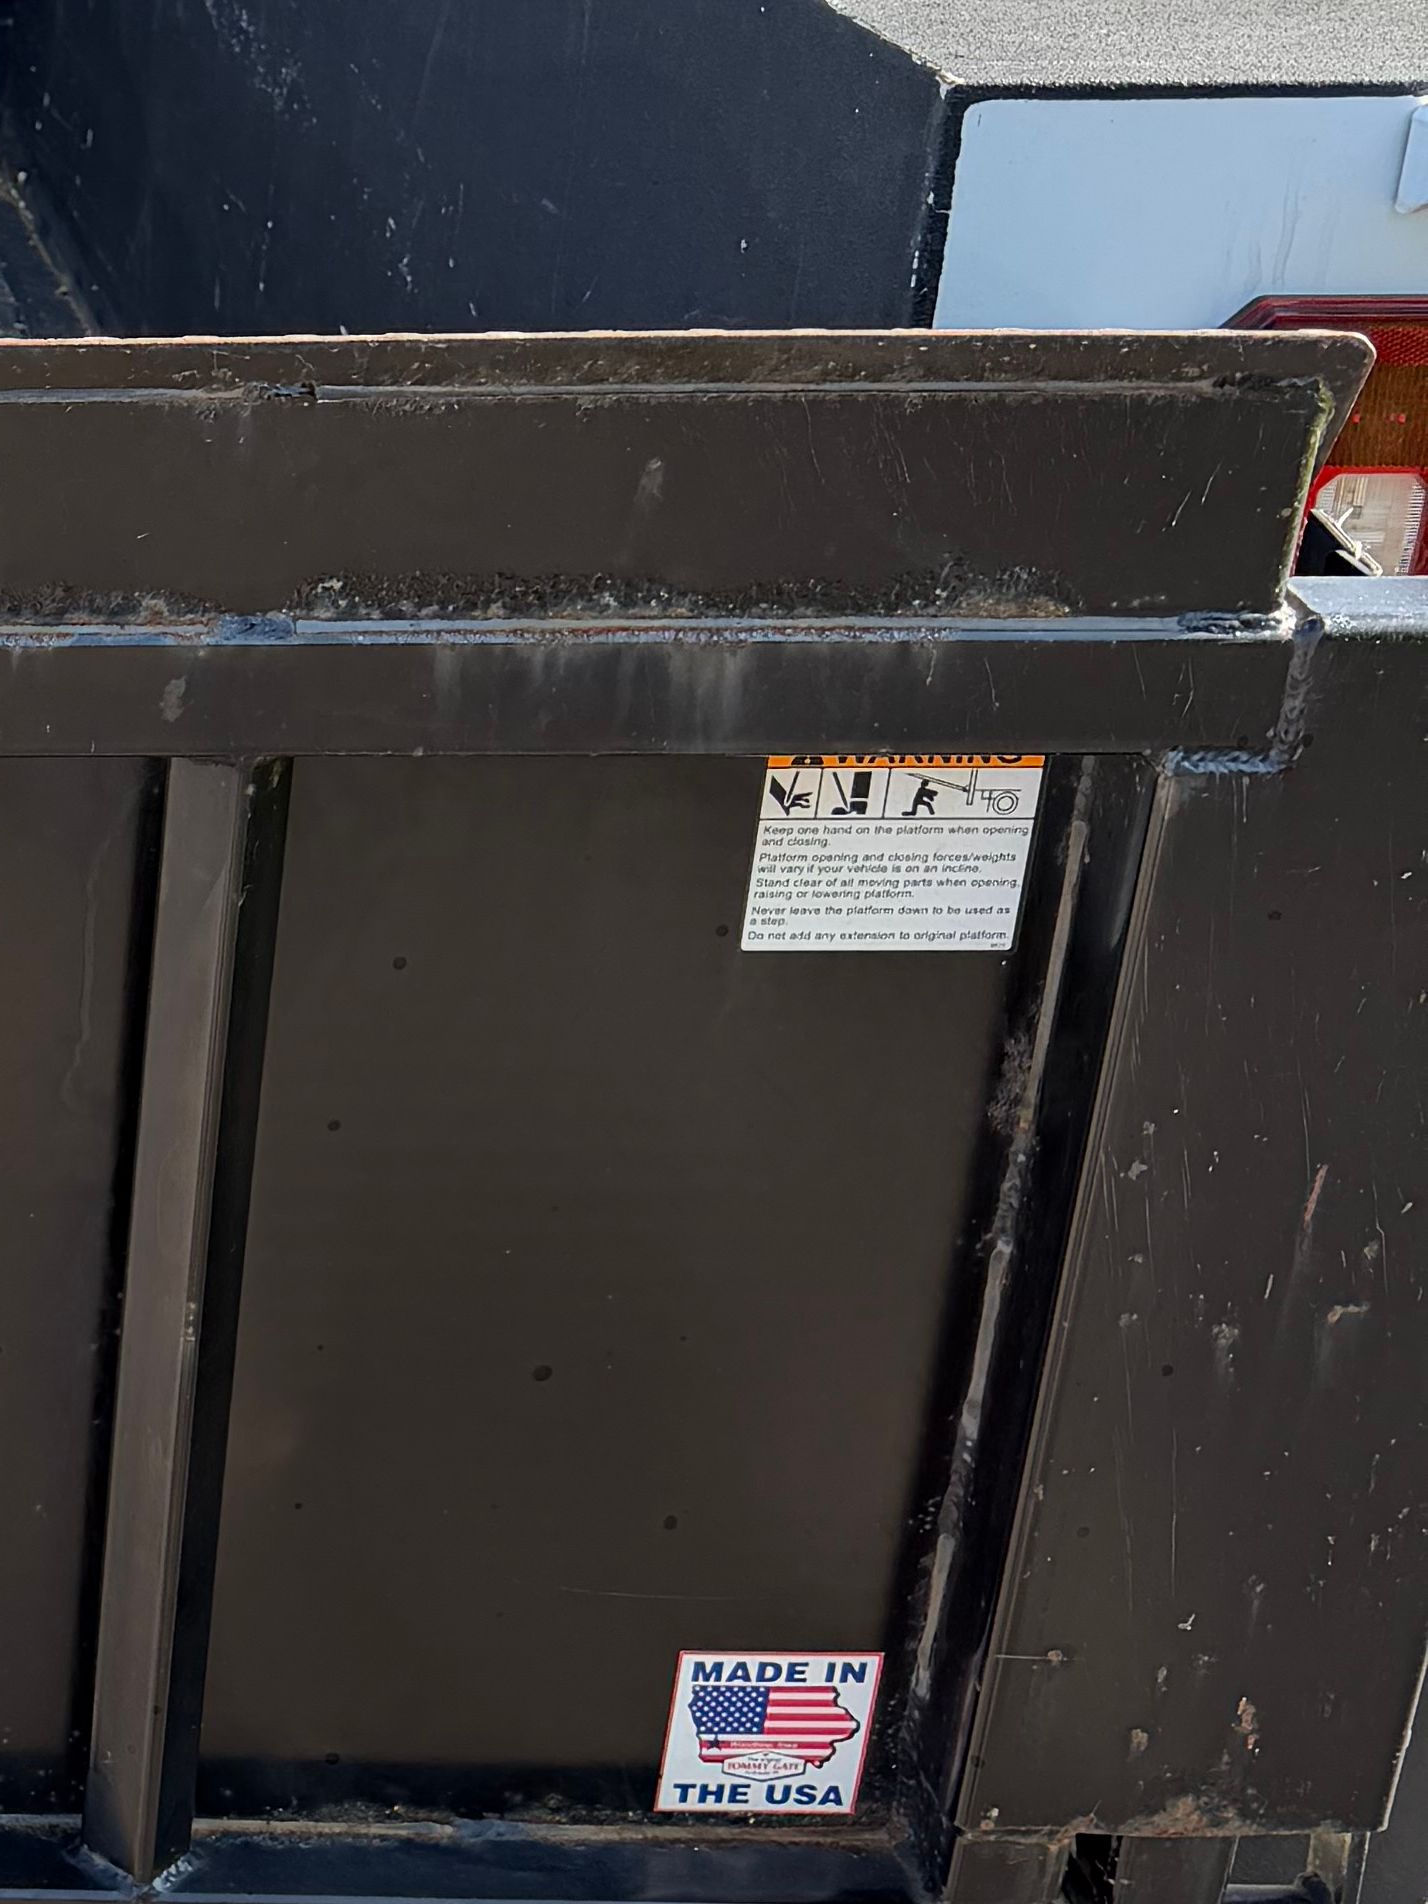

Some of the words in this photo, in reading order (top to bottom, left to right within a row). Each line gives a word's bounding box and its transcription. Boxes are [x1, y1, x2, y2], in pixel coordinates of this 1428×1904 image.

[763, 825, 794, 836] Keep
[797, 826, 819, 835] one
[823, 825, 852, 835] hand
[855, 827, 870, 835] on
[874, 825, 892, 834] the
[896, 825, 944, 836] platform
[948, 825, 979, 834] when
[982, 825, 1029, 836] opening
[761, 837, 783, 846] and
[787, 837, 831, 848] closing.
[758, 852, 808, 862] Platform
[811, 853, 858, 864] opening
[861, 853, 884, 862] and
[888, 852, 929, 863] closing
[932, 852, 1016, 864] forces/weights
[757, 864, 776, 873] will
[779, 865, 804, 875] vary
[806, 864, 814, 873] if
[817, 865, 843, 875] your
[847, 863, 888, 873] vehicle
[891, 864, 901, 873] is
[904, 865, 920, 873] on
[924, 865, 938, 873] an
[756, 877, 790, 887] Stand
[793, 878, 823, 887] clear
[825, 878, 838, 887] of
[840, 878, 854, 887] all
[857, 878, 899, 889] moving
[903, 878, 933, 888] parts
[936, 878, 966, 887] when
[753, 889, 793, 900] raising
[811, 889, 861, 900] lowering
[864, 889, 914, 899] platform.
[751, 906, 786, 915] Never
[789, 906, 821, 915] leave
[825, 906, 842, 915] the
[846, 906, 894, 916] platform
[898, 906, 929, 915] down
[932, 906, 943, 915] to
[946, 906, 961, 915] be
[964, 906, 993, 915] used
[749, 918, 757, 926] a
[747, 931, 764, 940] Do
[767, 931, 786, 940] not
[789, 931, 811, 940] add
[814, 932, 836, 942] any
[839, 931, 895, 940] extension
[899, 931, 910, 940] to
[913, 931, 956, 942] original
[959, 931, 1009, 941] platform.
[691, 1661, 809, 1683] MADE
[824, 1662, 868, 1683] IN
[673, 1783, 751, 1804] THE
[765, 1784, 843, 1806] USA
